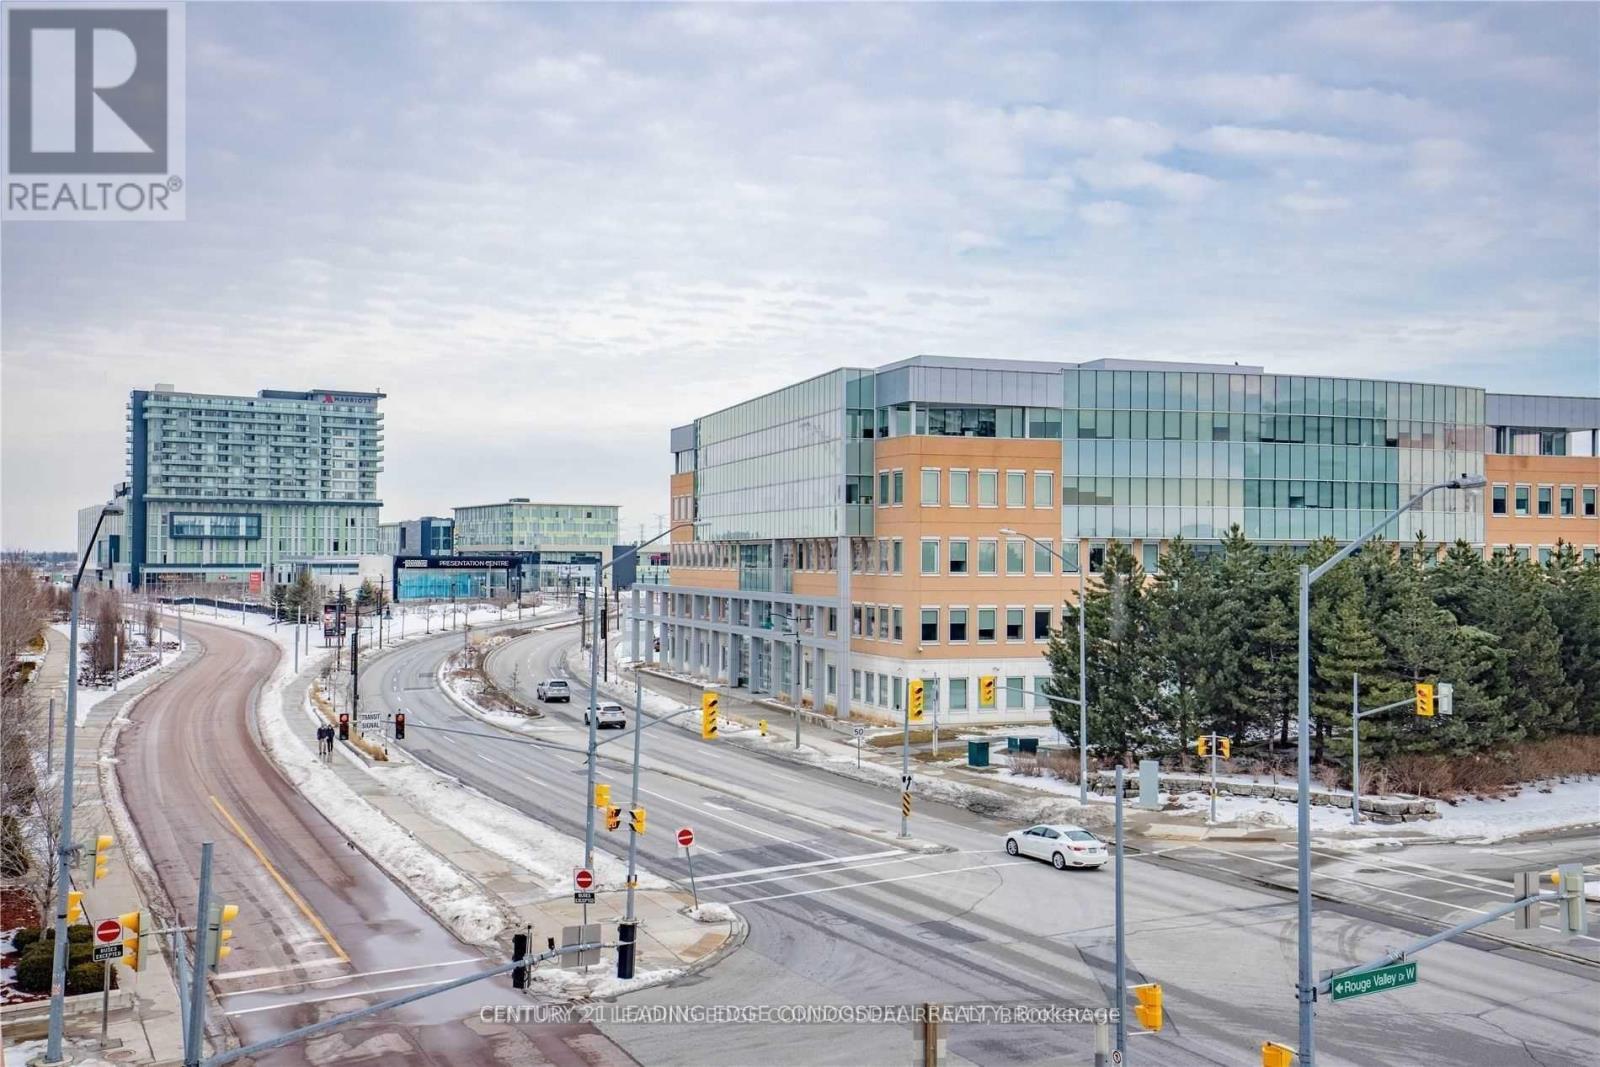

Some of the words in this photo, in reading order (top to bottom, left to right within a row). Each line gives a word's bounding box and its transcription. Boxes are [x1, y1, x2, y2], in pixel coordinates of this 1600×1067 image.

[854, 728, 863, 736] 50
[96, 951, 121, 960] EXCEPTED
[1344, 979, 1372, 992] Rouge
[1373, 973, 1397, 985] Valley
[1398, 973, 1405, 981] Dr
[1406, 967, 1415, 979] W
